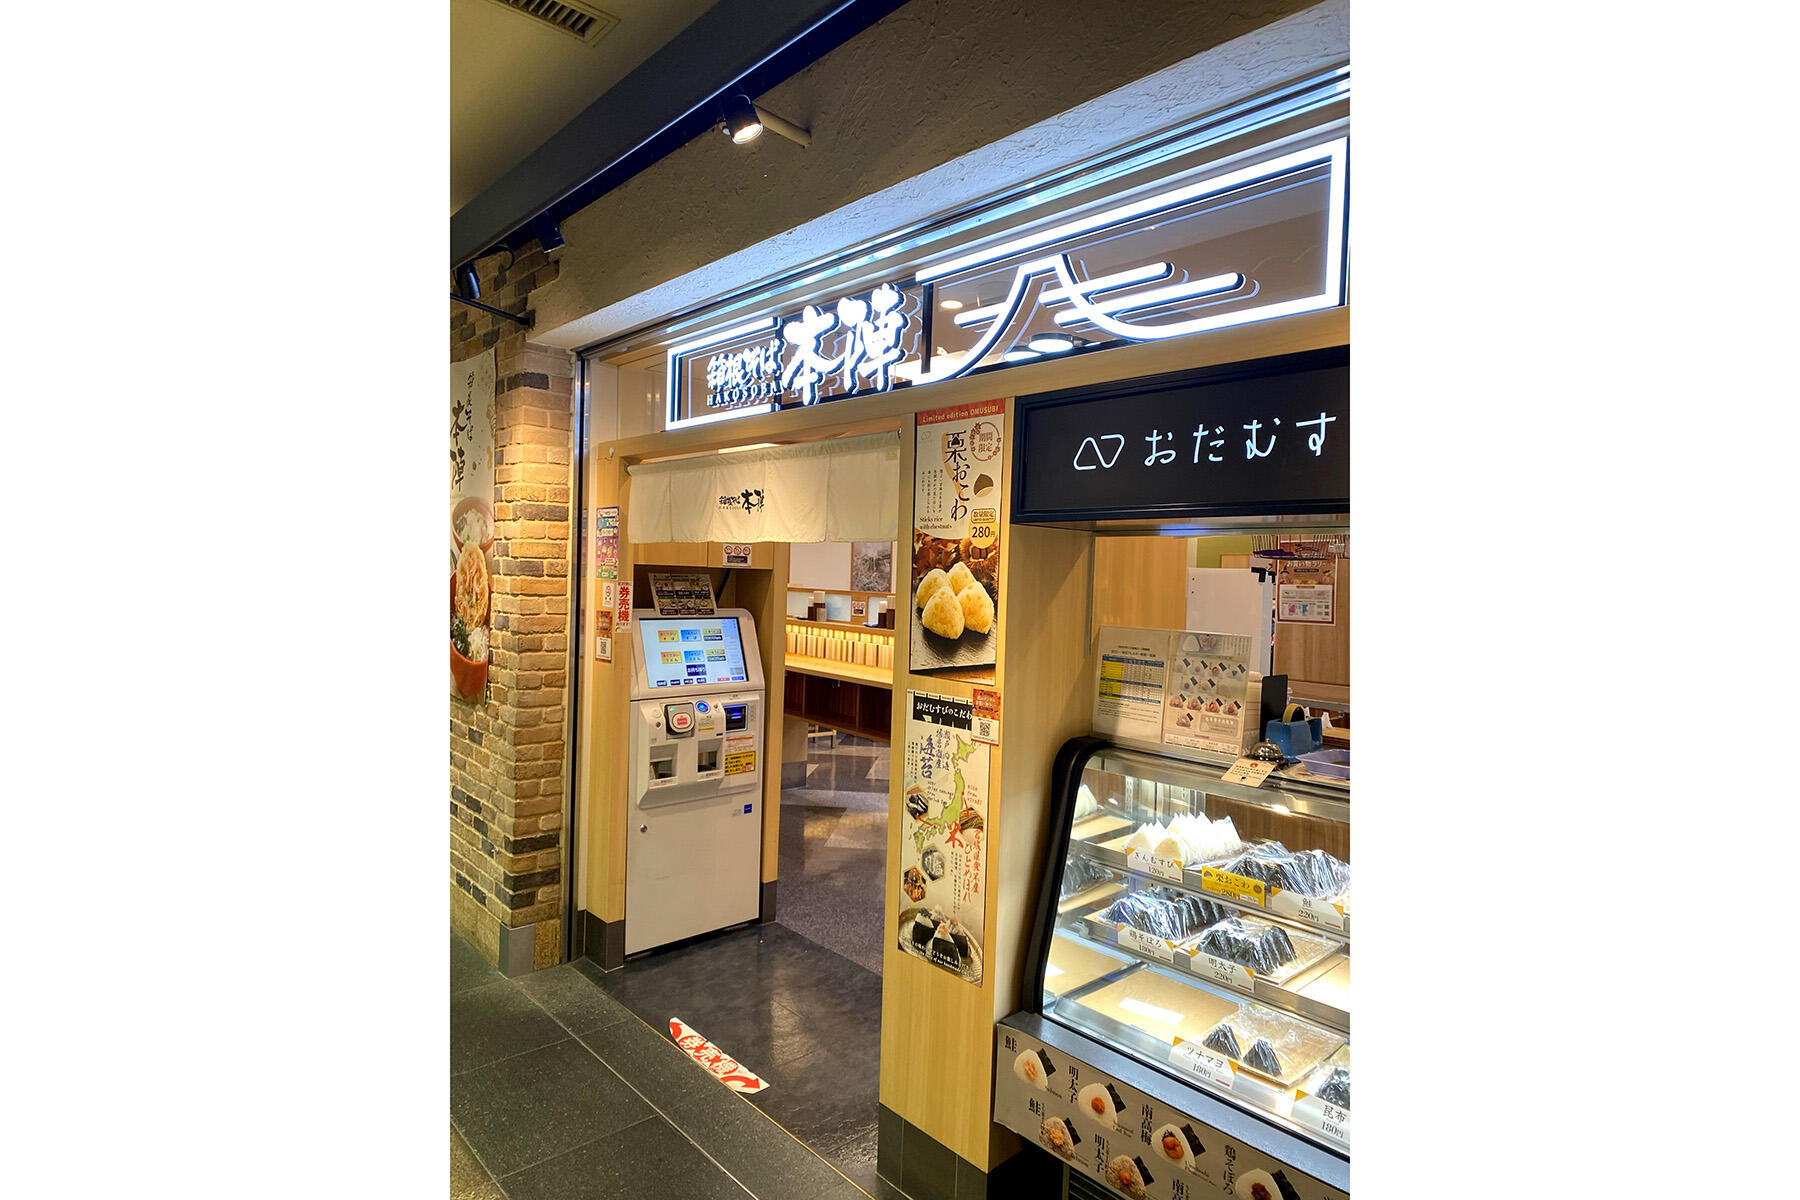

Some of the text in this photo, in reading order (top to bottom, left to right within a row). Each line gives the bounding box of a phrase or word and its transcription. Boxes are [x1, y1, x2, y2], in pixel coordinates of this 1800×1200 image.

[782, 282, 905, 406] 本陣
[706, 380, 780, 406] HAKOSOBA
[922, 405, 999, 423] Limited edition OMUSUBI
[1143, 411, 1337, 467] おだむす
[944, 430, 970, 522] 栗おこわ
[972, 526, 996, 538] 280円
[618, 586, 630, 622] 券売機
[945, 820, 964, 848] 米
[1208, 957, 1237, 973] 明太子
[1214, 971, 1233, 984] 220円
[1004, 1035, 1017, 1053] 鮭
[1187, 1047, 1224, 1068] ツナマヨ
[1192, 1063, 1212, 1079] 180円
[1068, 1065, 1079, 1104] 明太子
[1028, 1098, 1041, 1117] 鮭
[1323, 1105, 1348, 1123] 昆布
[1141, 1104, 1153, 1146] 南高梅
[1321, 1121, 1344, 1139] 180円
[1094, 1134, 1105, 1174] 明太子
